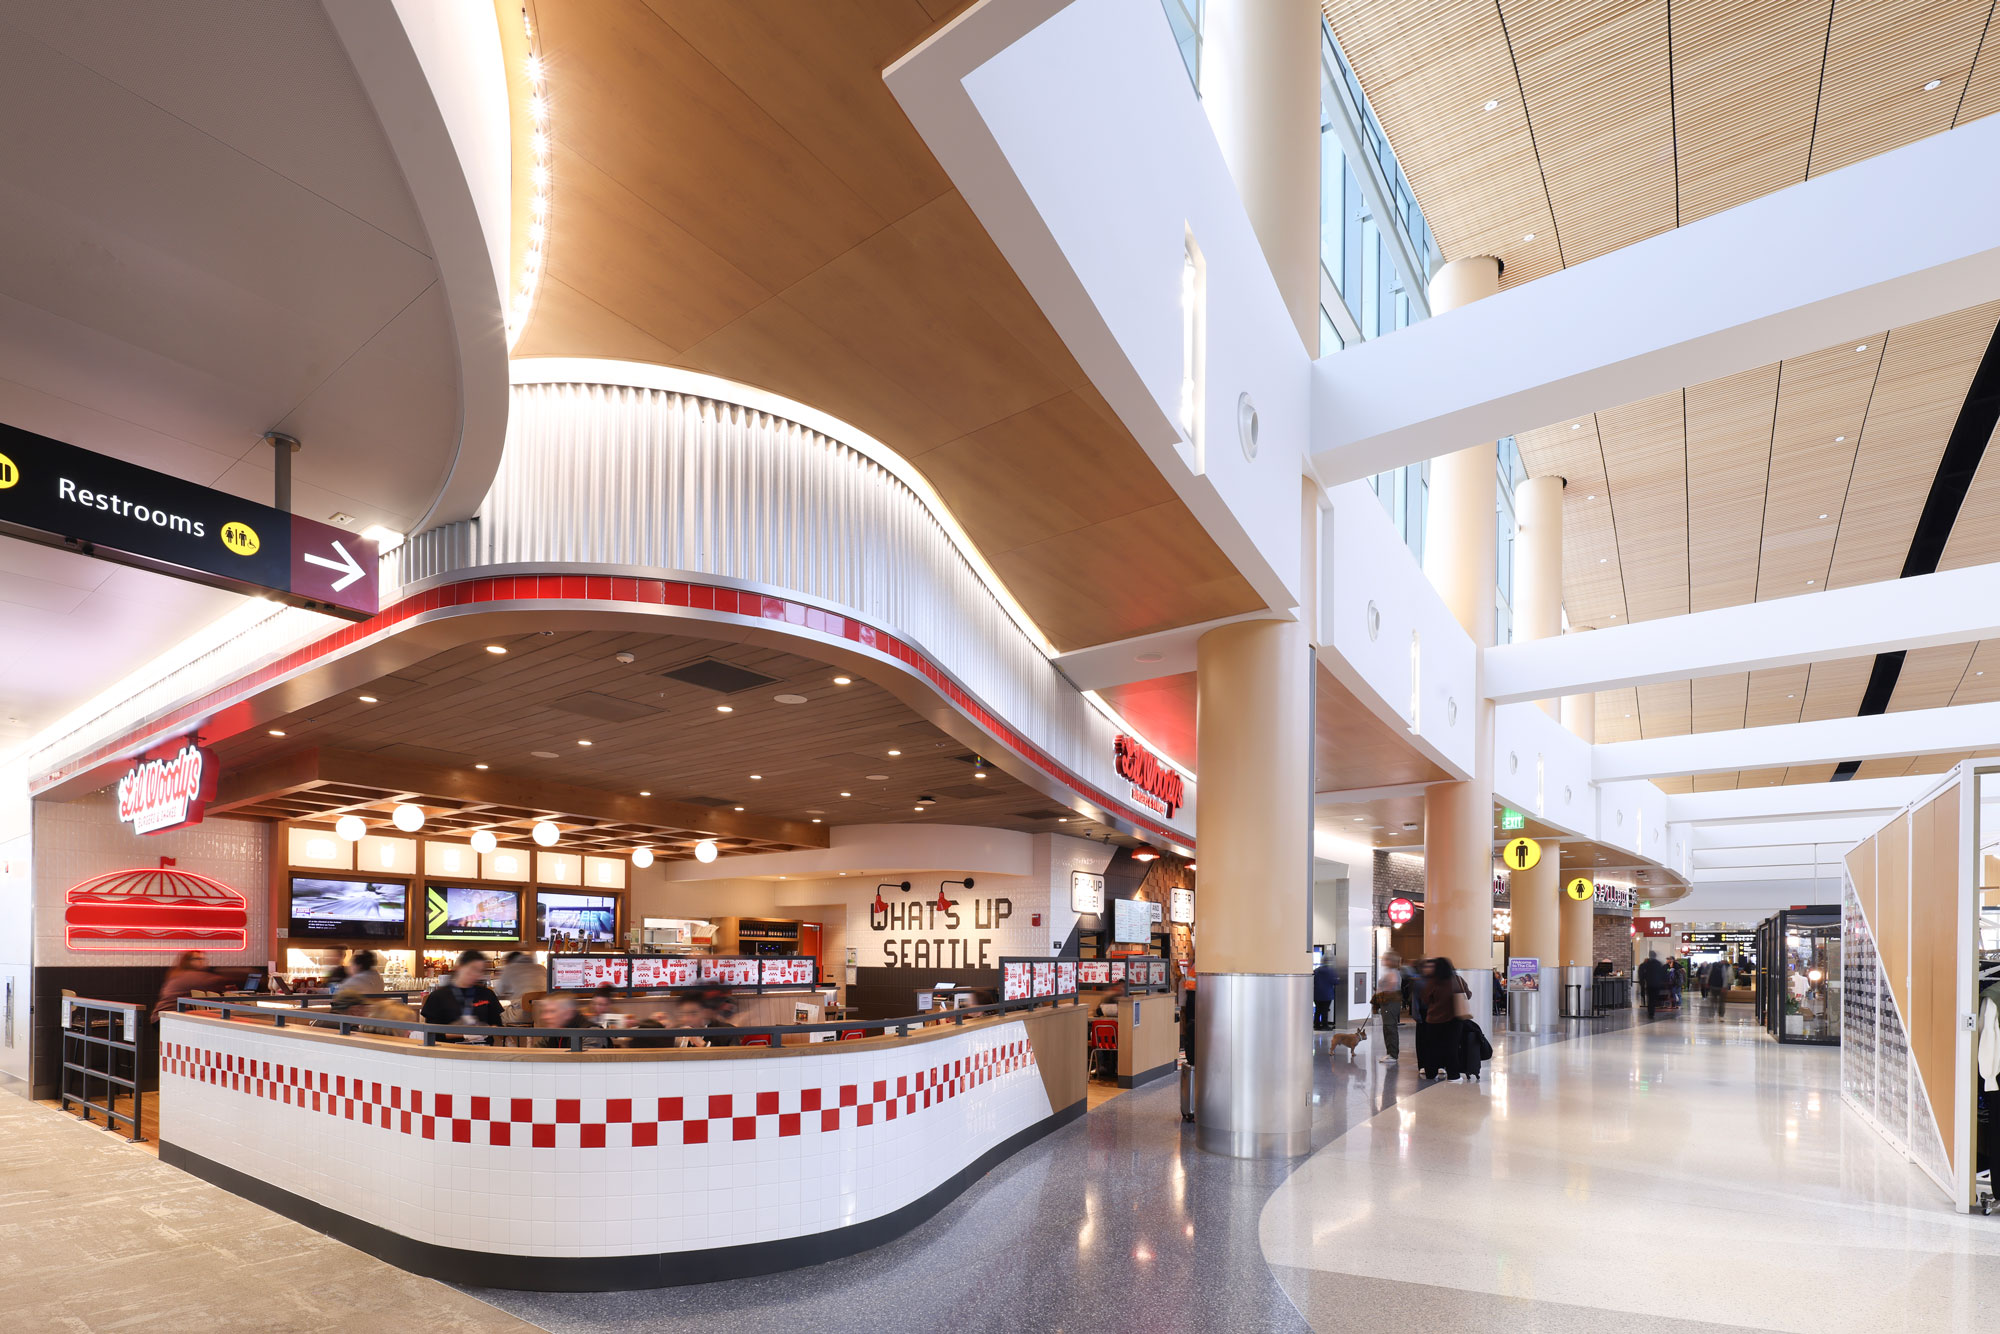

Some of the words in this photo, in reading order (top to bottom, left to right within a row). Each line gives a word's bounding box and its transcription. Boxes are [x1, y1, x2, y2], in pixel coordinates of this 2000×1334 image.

[59, 477, 205, 537] Restrooms
[145, 751, 200, 818] Woody's
[1505, 816, 1523, 828] EXIT
[975, 898, 1013, 930] UP
[1650, 920, 1664, 929] N9
[884, 938, 992, 969] SEATTLE
